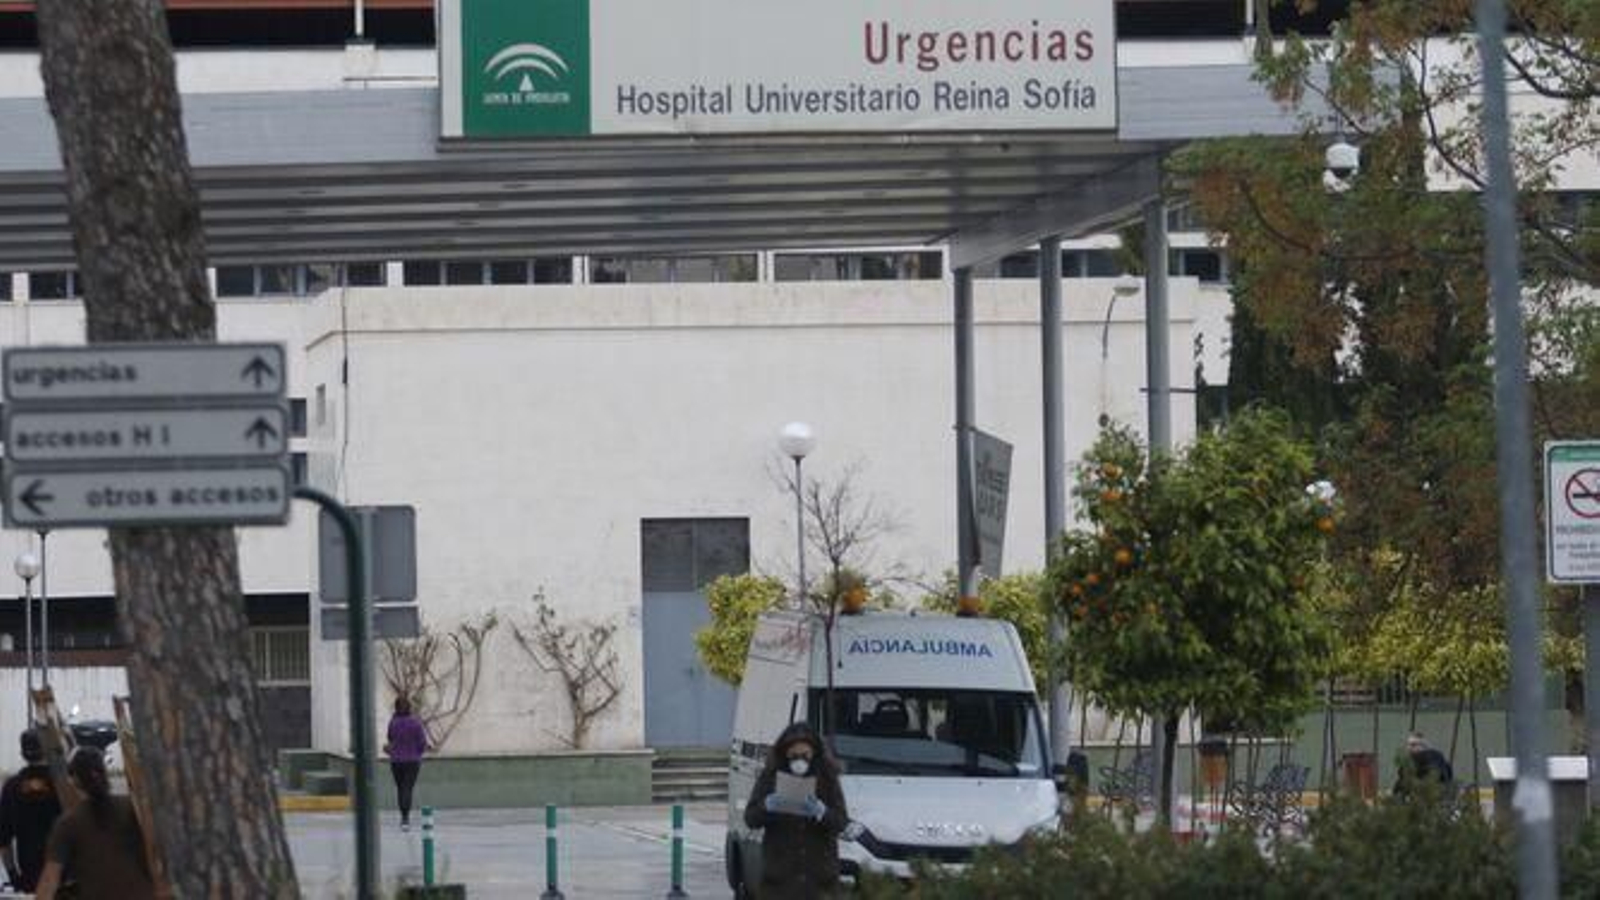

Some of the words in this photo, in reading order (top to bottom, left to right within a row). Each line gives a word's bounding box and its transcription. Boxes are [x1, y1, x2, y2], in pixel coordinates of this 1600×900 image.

[865, 20, 1094, 71] Urgencias
[617, 84, 733, 120] Hospital
[746, 82, 921, 114] Universitario
[934, 81, 1010, 111] Reina
[1023, 78, 1097, 109] Sofía
[13, 361, 136, 387] urgencias
[16, 428, 122, 448] accesos
[133, 424, 152, 446] H
[85, 485, 157, 507] otros
[170, 486, 279, 506] accesos
